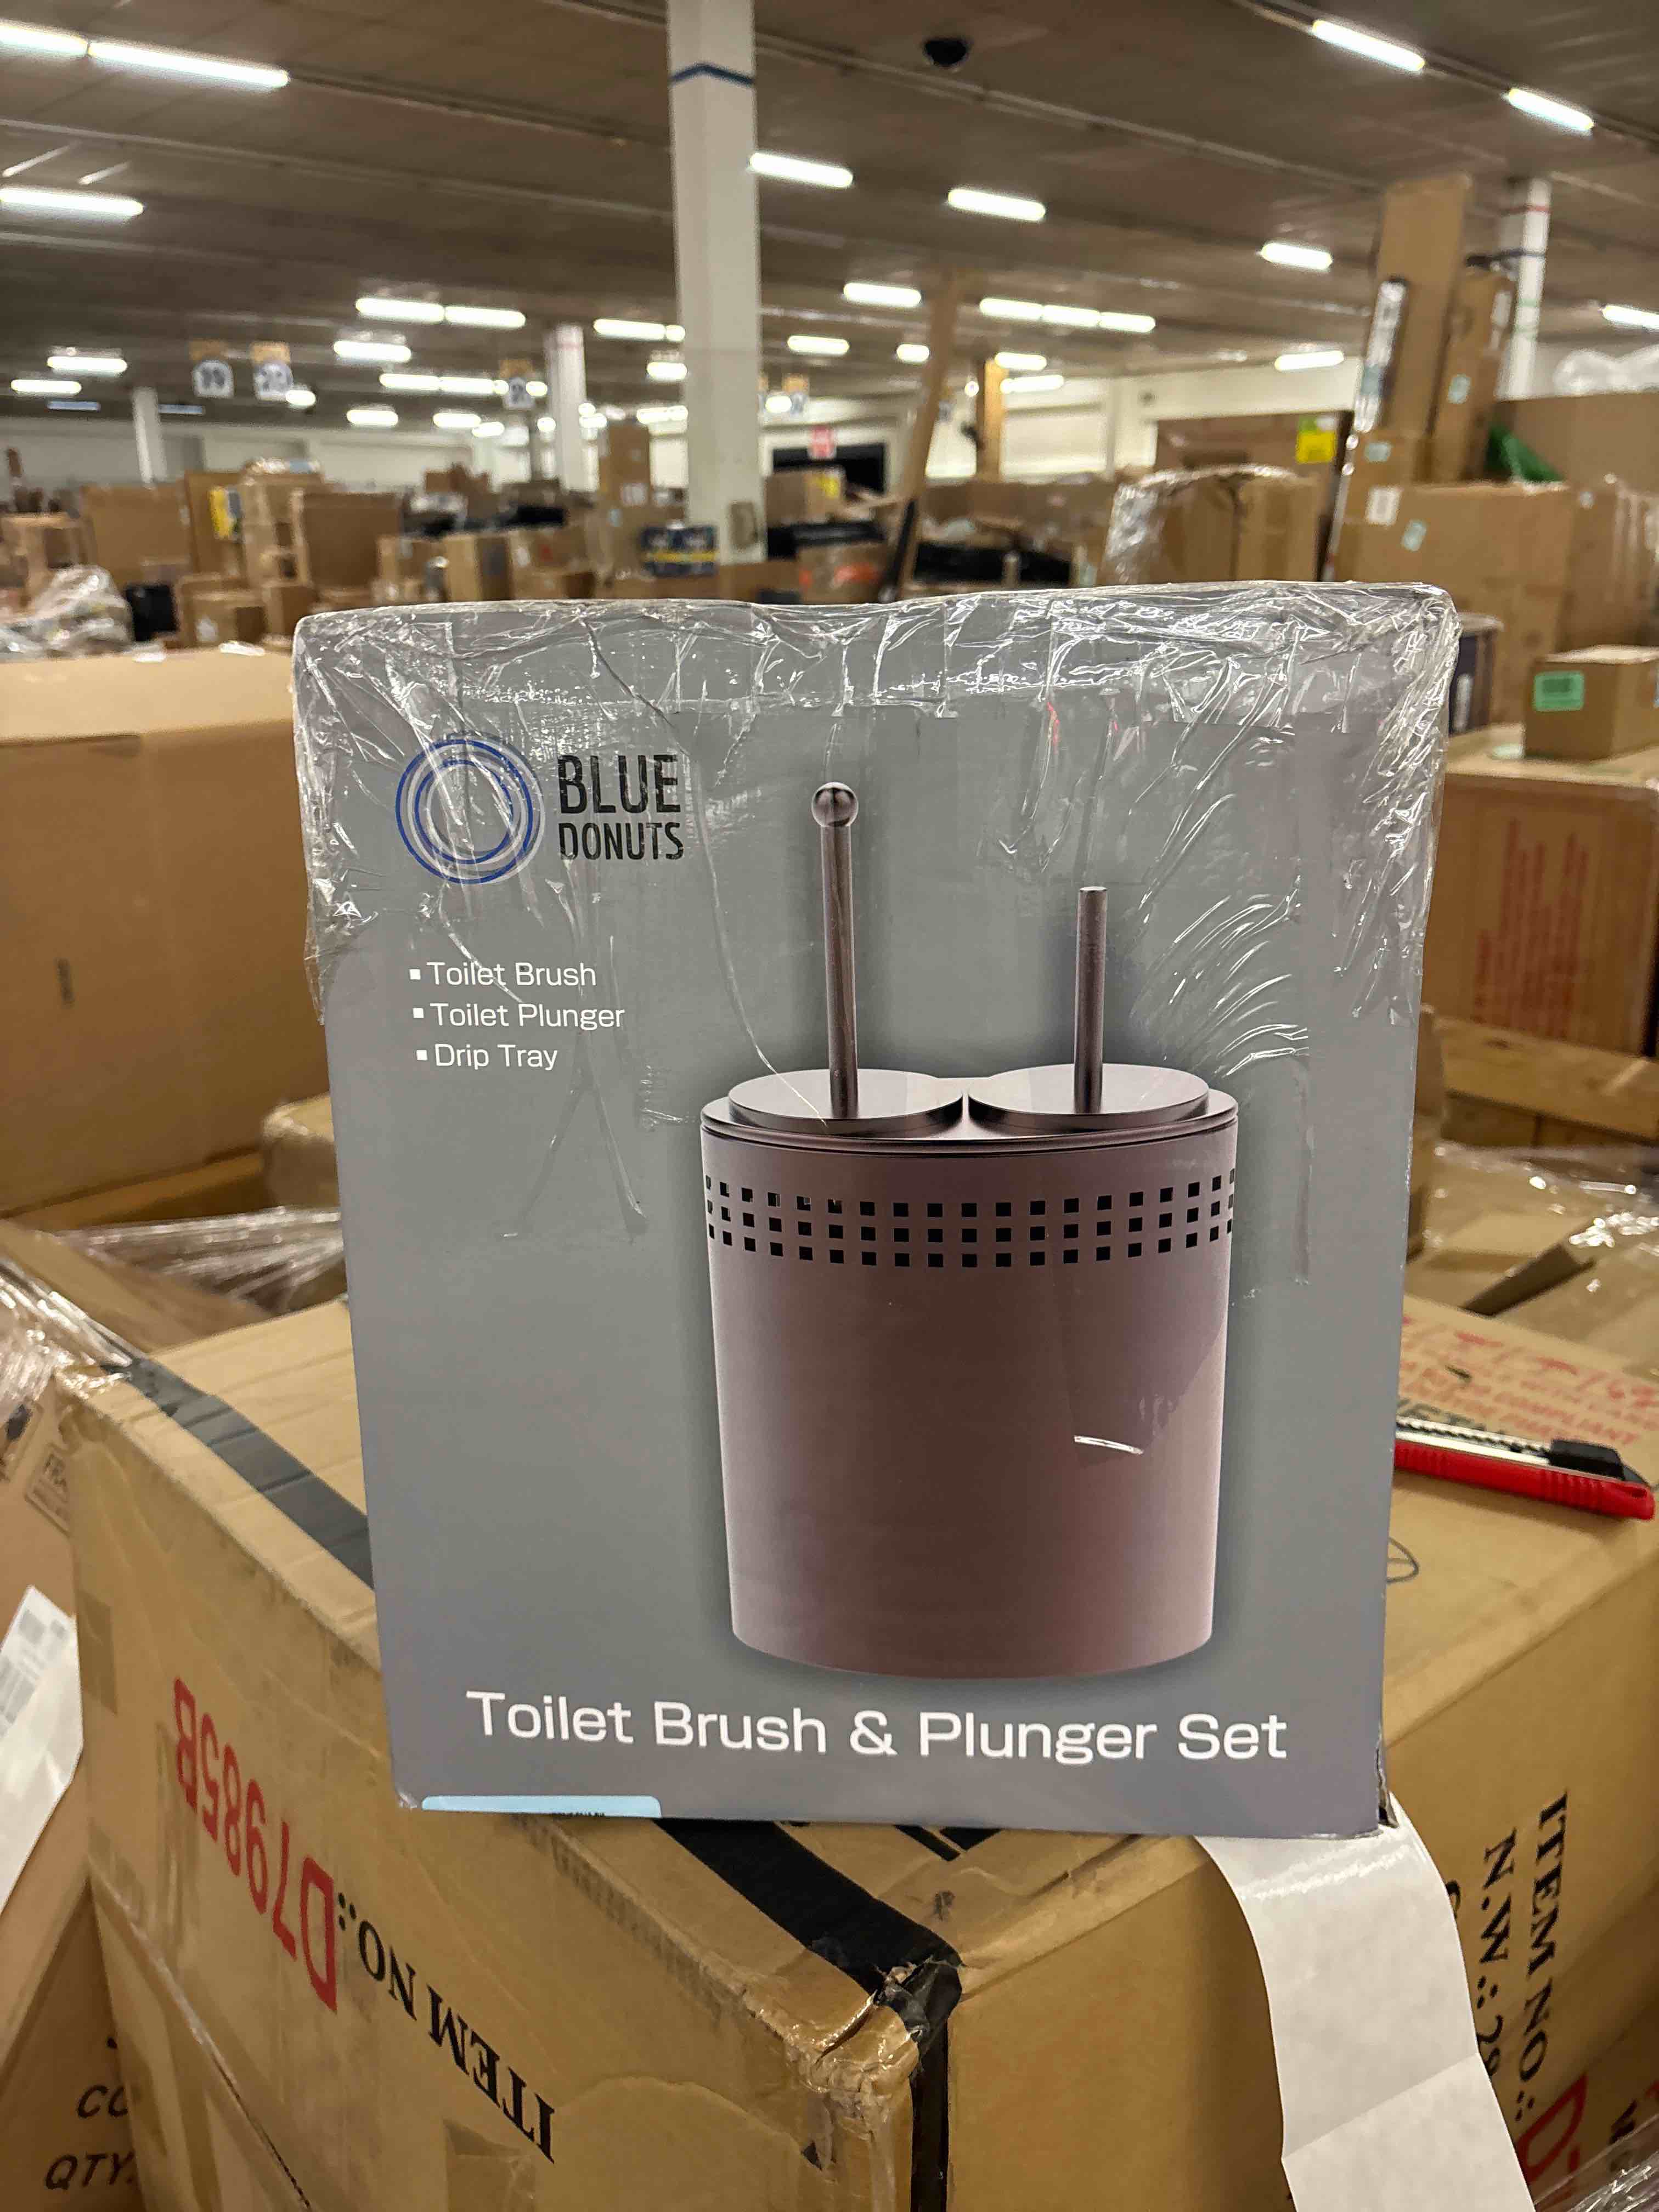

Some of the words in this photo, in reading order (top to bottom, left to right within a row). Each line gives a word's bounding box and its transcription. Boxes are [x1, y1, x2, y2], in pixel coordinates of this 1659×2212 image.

[557, 754, 681, 814] BLUE
[559, 822, 684, 861] DONUTS
[426, 962, 505, 986] Toilet
[515, 962, 596, 986] Brush
[430, 1003, 509, 1026] Toilet
[518, 1003, 625, 1030] Plunger
[435, 1043, 489, 1070] Drip
[498, 1044, 558, 1071] Tray
[466, 1690, 634, 1745] Toilet
[654, 1700, 827, 1753] Brush
[849, 1710, 898, 1756] &
[919, 1711, 1158, 1765] Plunger
[1178, 1713, 1288, 1759] Set
[1527, 1787, 1568, 1979] ITEM
[426, 1983, 555, 2164] ITEM
